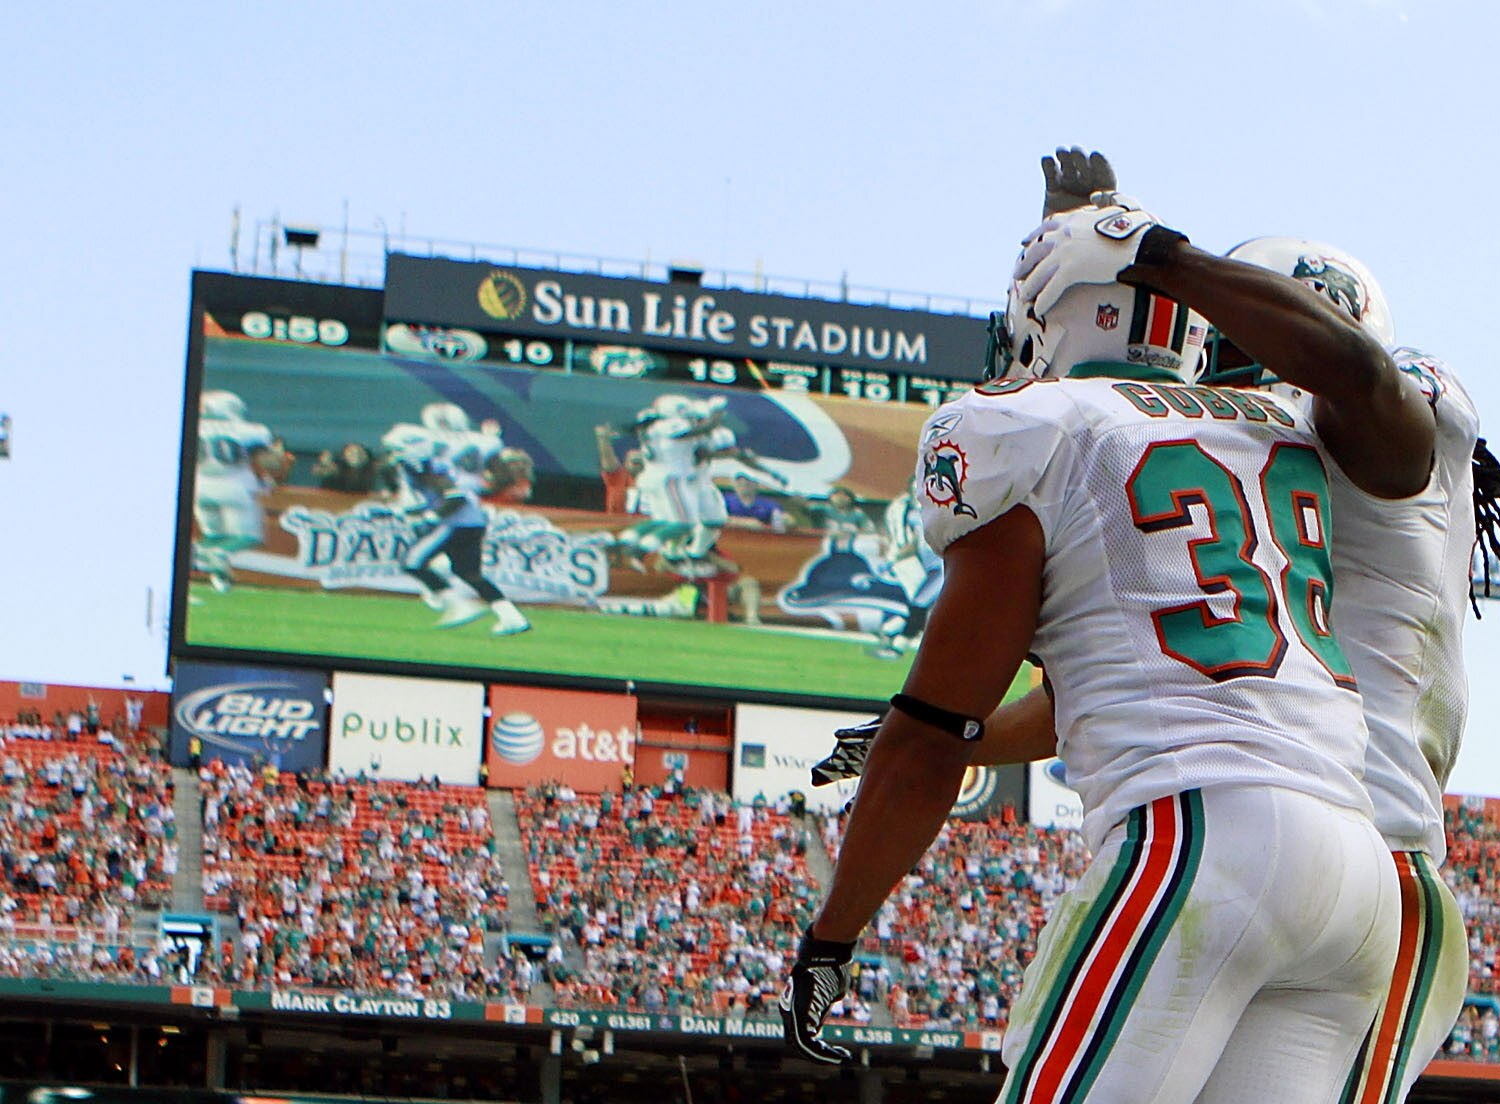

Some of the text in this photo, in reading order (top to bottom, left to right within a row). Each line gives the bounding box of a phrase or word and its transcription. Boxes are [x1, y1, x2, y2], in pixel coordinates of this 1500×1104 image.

[533, 280, 927, 364] Sun Life STADIUM
[1124, 439, 1359, 693] 38
[216, 693, 315, 720] BUD
[195, 710, 321, 741] LIGHT
[342, 712, 463, 747] Publix
[551, 722, 636, 763] at&t
[271, 991, 452, 1019] MARK CLAYTON 83
[550, 1012, 579, 1027] 420
[680, 1016, 720, 1035] DAN
[726, 1018, 786, 1040] MARIN
